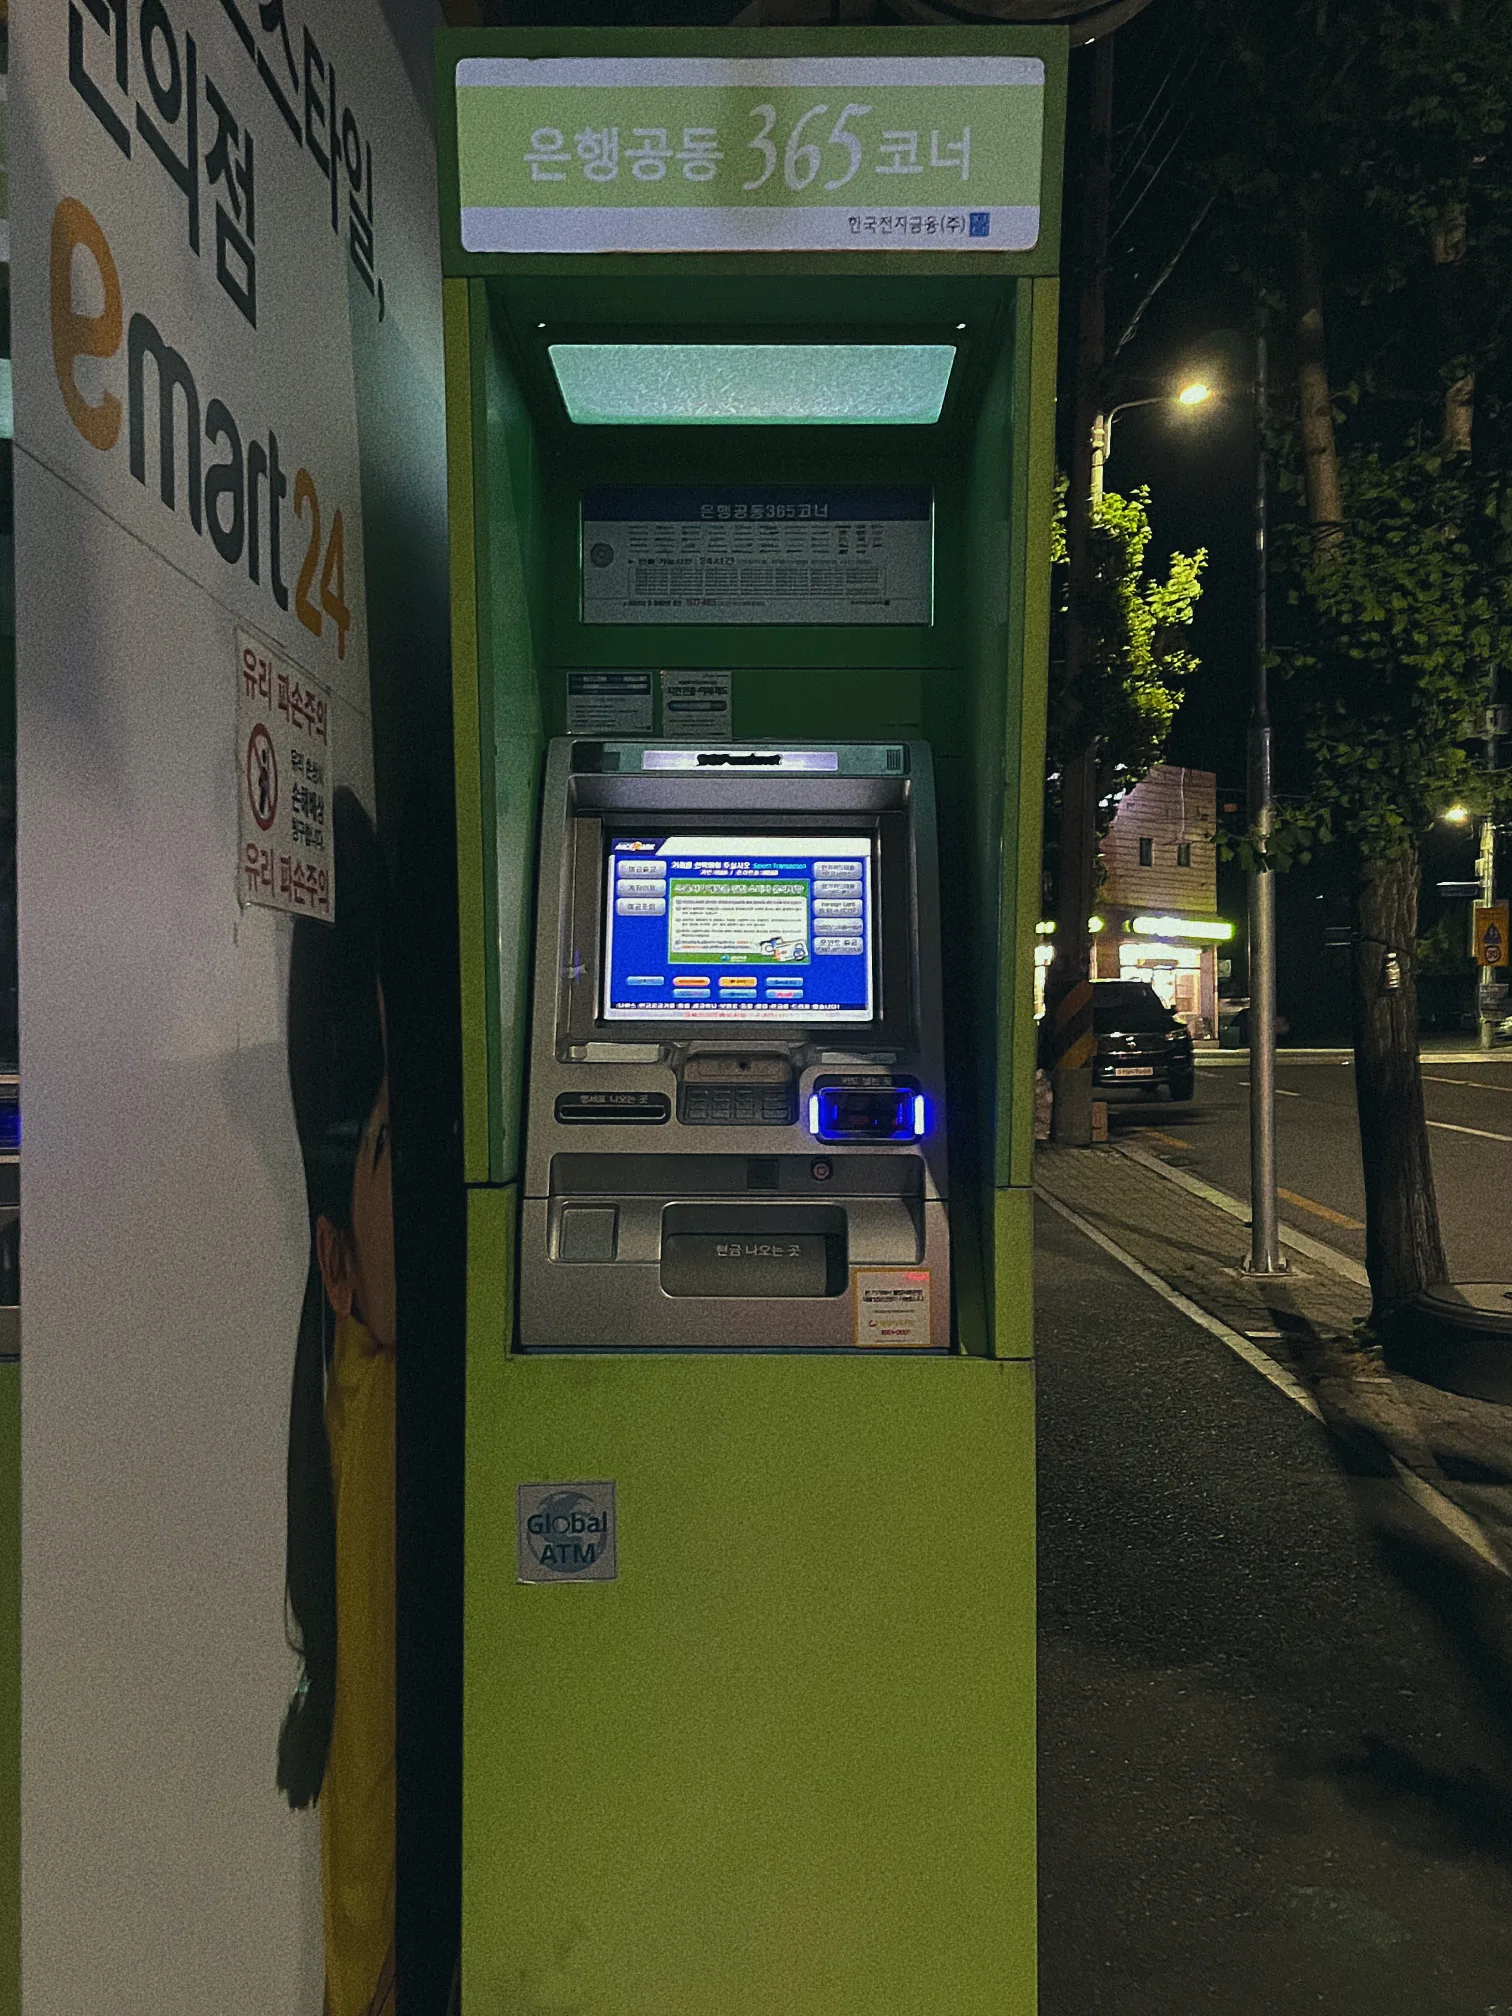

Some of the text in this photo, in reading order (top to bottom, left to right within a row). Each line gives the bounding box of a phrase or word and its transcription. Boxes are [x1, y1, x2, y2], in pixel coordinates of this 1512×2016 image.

[524, 103, 970, 192] 은행공동 365 코너
[49, 196, 350, 661] emart24
[243, 648, 328, 746] 유리 파손주의
[245, 842, 329, 913] 유리 파손주의
[609, 1095, 635, 1104] 나오는
[716, 1244, 801, 1257] 현금 나오는 곳
[527, 1510, 608, 1534] Global
[540, 1543, 596, 1564] ATM
